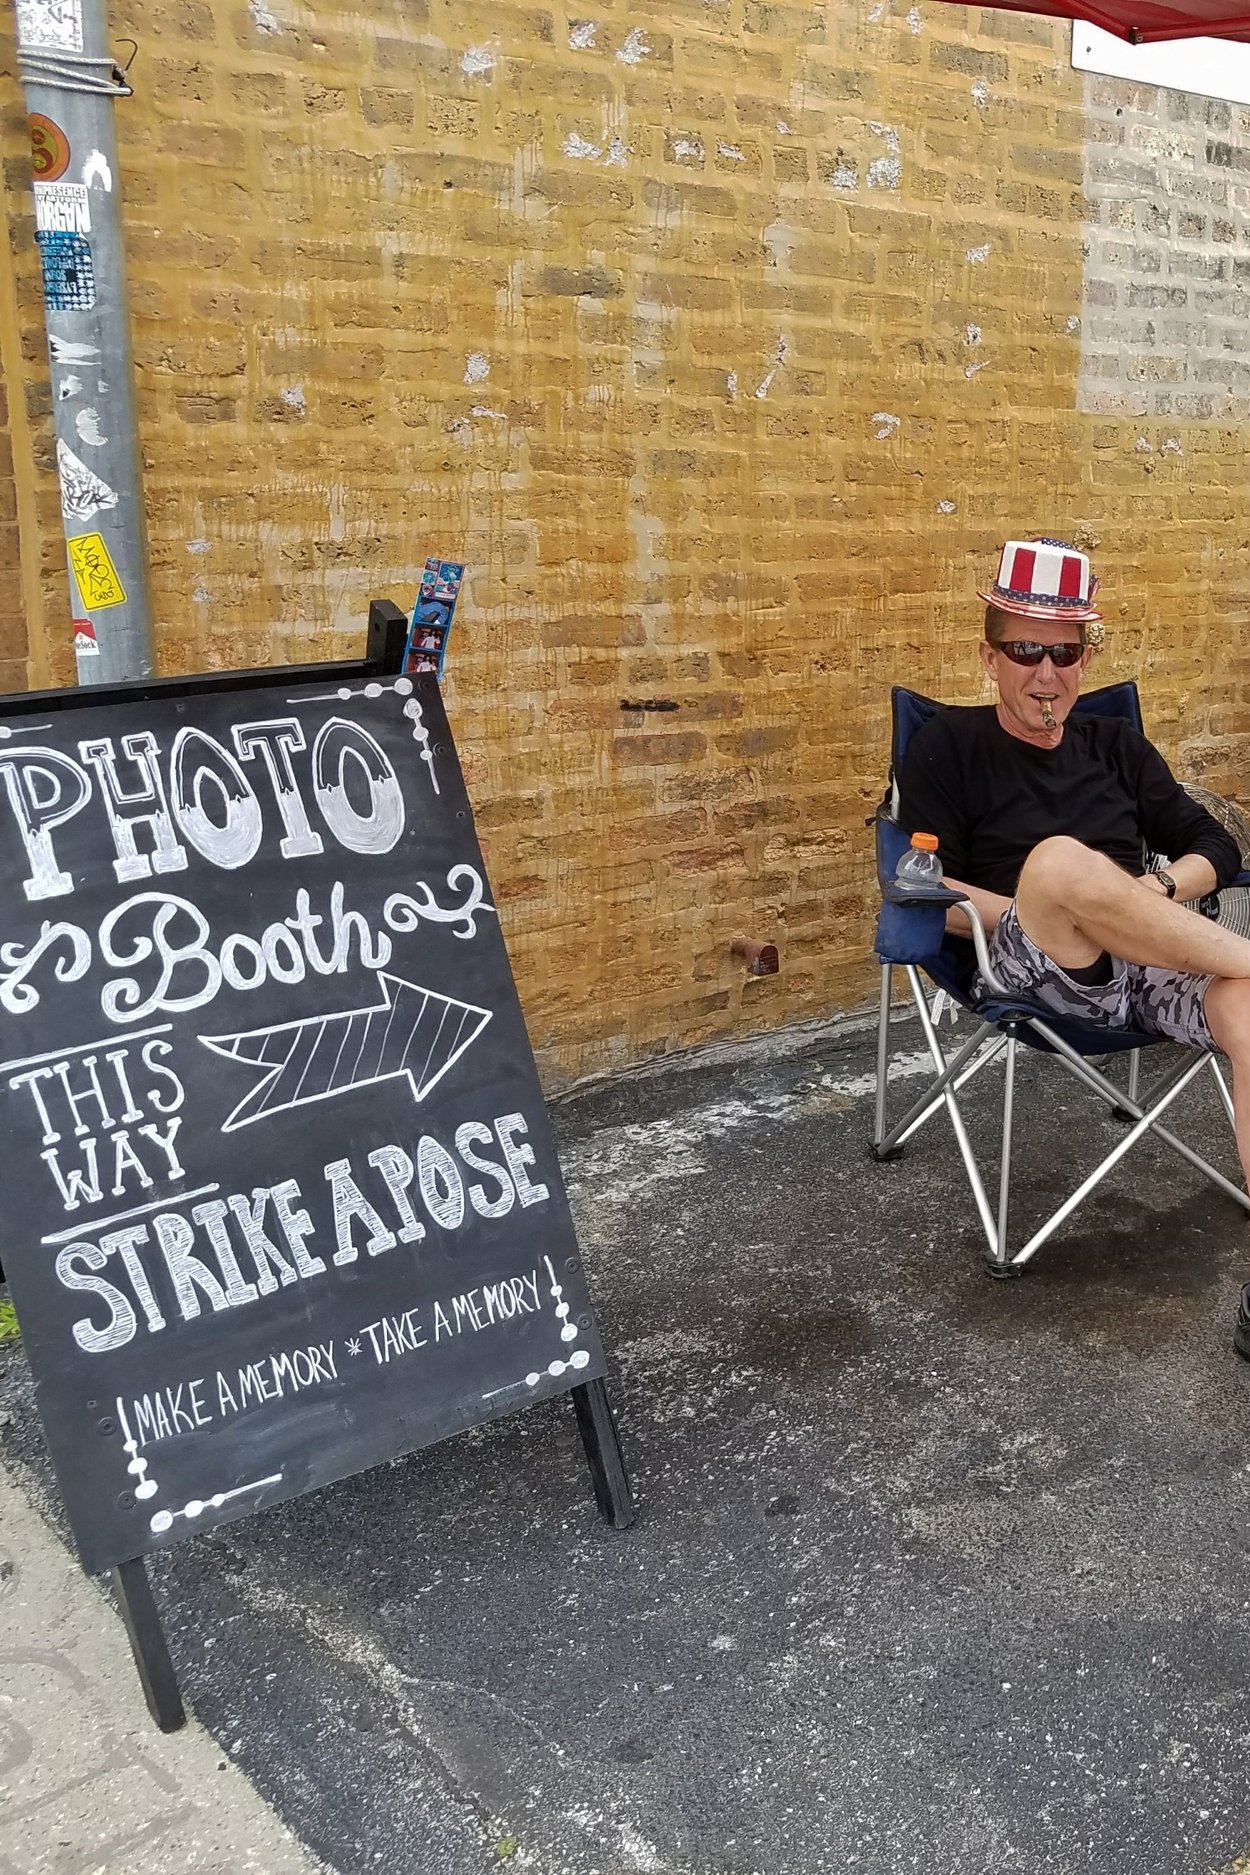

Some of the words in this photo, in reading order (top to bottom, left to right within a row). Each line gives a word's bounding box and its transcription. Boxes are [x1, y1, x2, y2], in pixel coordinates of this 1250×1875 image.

[0, 716, 406, 901] PHOTO
[100, 881, 393, 1024] Booth
[9, 1040, 186, 1144] THIS
[41, 1117, 184, 1210] WAY
[55, 1179, 327, 1353] STRIKE
[324, 1157, 397, 1266] A
[368, 1112, 551, 1242] POSE
[134, 1378, 213, 1447] MAKE
[216, 1370, 239, 1417] A
[238, 1340, 338, 1408] MEMORY
[359, 1308, 428, 1365] TAKE
[434, 1301, 453, 1342] A
[451, 1269, 542, 1334] MEMORY
